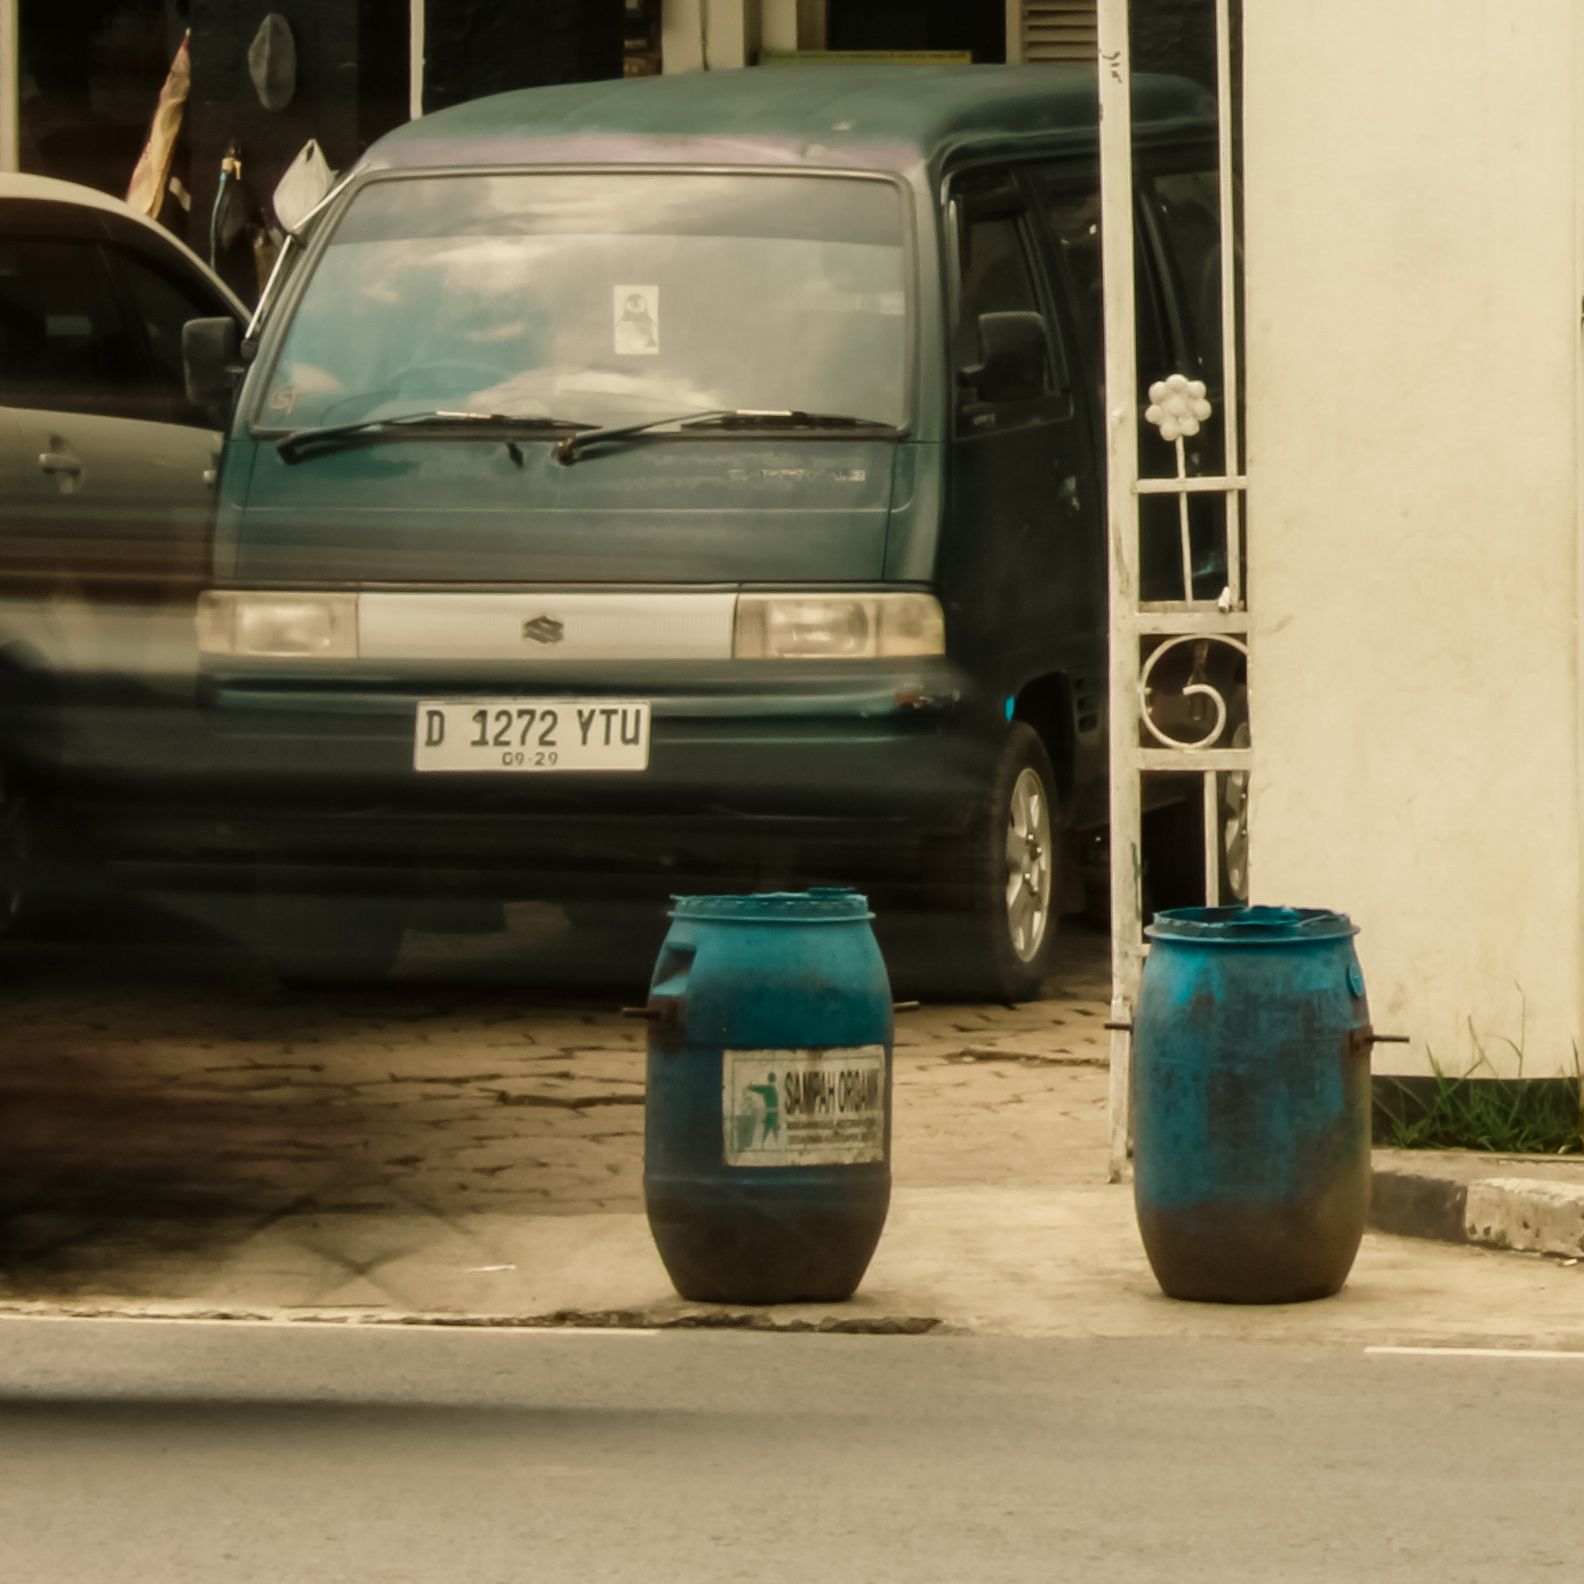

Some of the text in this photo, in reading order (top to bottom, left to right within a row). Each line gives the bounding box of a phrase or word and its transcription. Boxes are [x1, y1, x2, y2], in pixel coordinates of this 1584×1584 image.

[424, 708, 642, 748] D 1272 YTU
